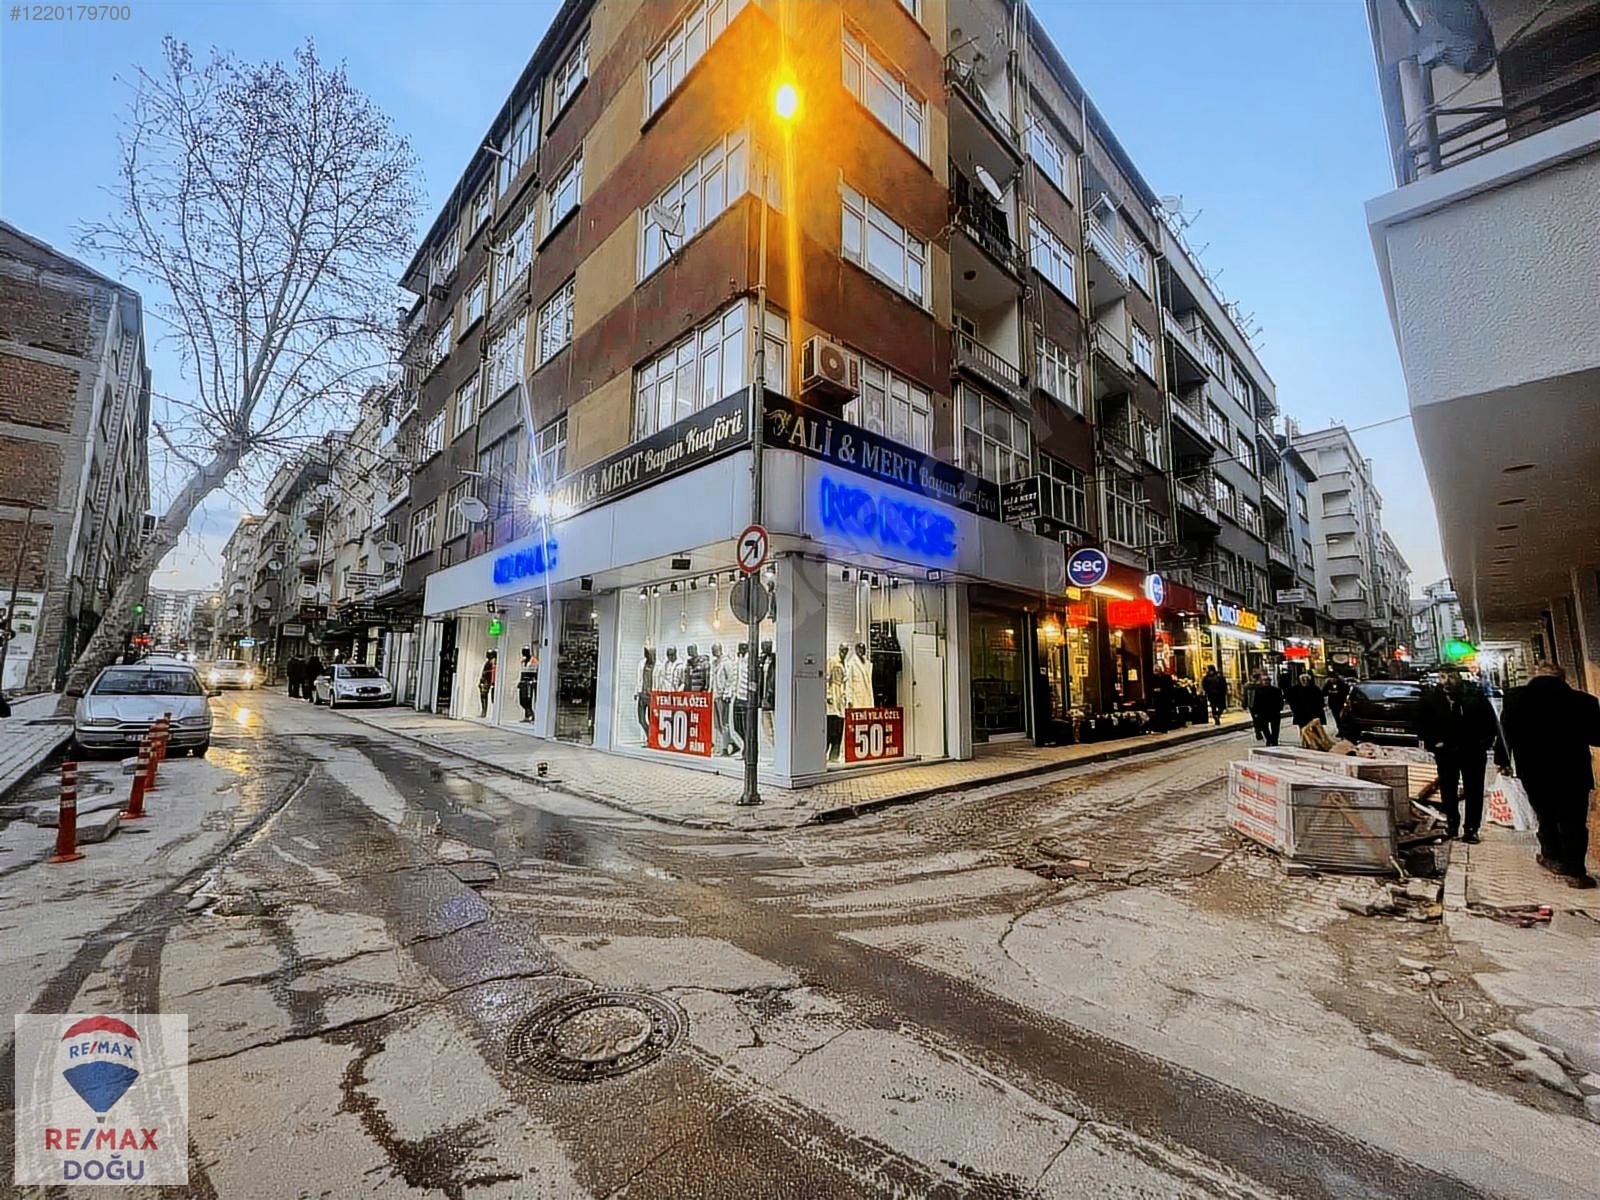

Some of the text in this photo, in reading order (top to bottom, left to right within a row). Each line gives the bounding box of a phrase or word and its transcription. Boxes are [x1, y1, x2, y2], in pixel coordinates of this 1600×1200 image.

[586, 473, 598, 500] &
[600, 451, 643, 495] MERT
[644, 449, 684, 473] Bayan
[685, 408, 744, 455] Kuaförü
[788, 415, 832, 457] ALİ
[838, 434, 856, 464] &
[862, 440, 917, 485] MERT
[919, 466, 957, 498] Bayan
[1072, 560, 1102, 574] seç
[656, 694, 671, 706] YENİ
[689, 694, 708, 708] ÖZEL
